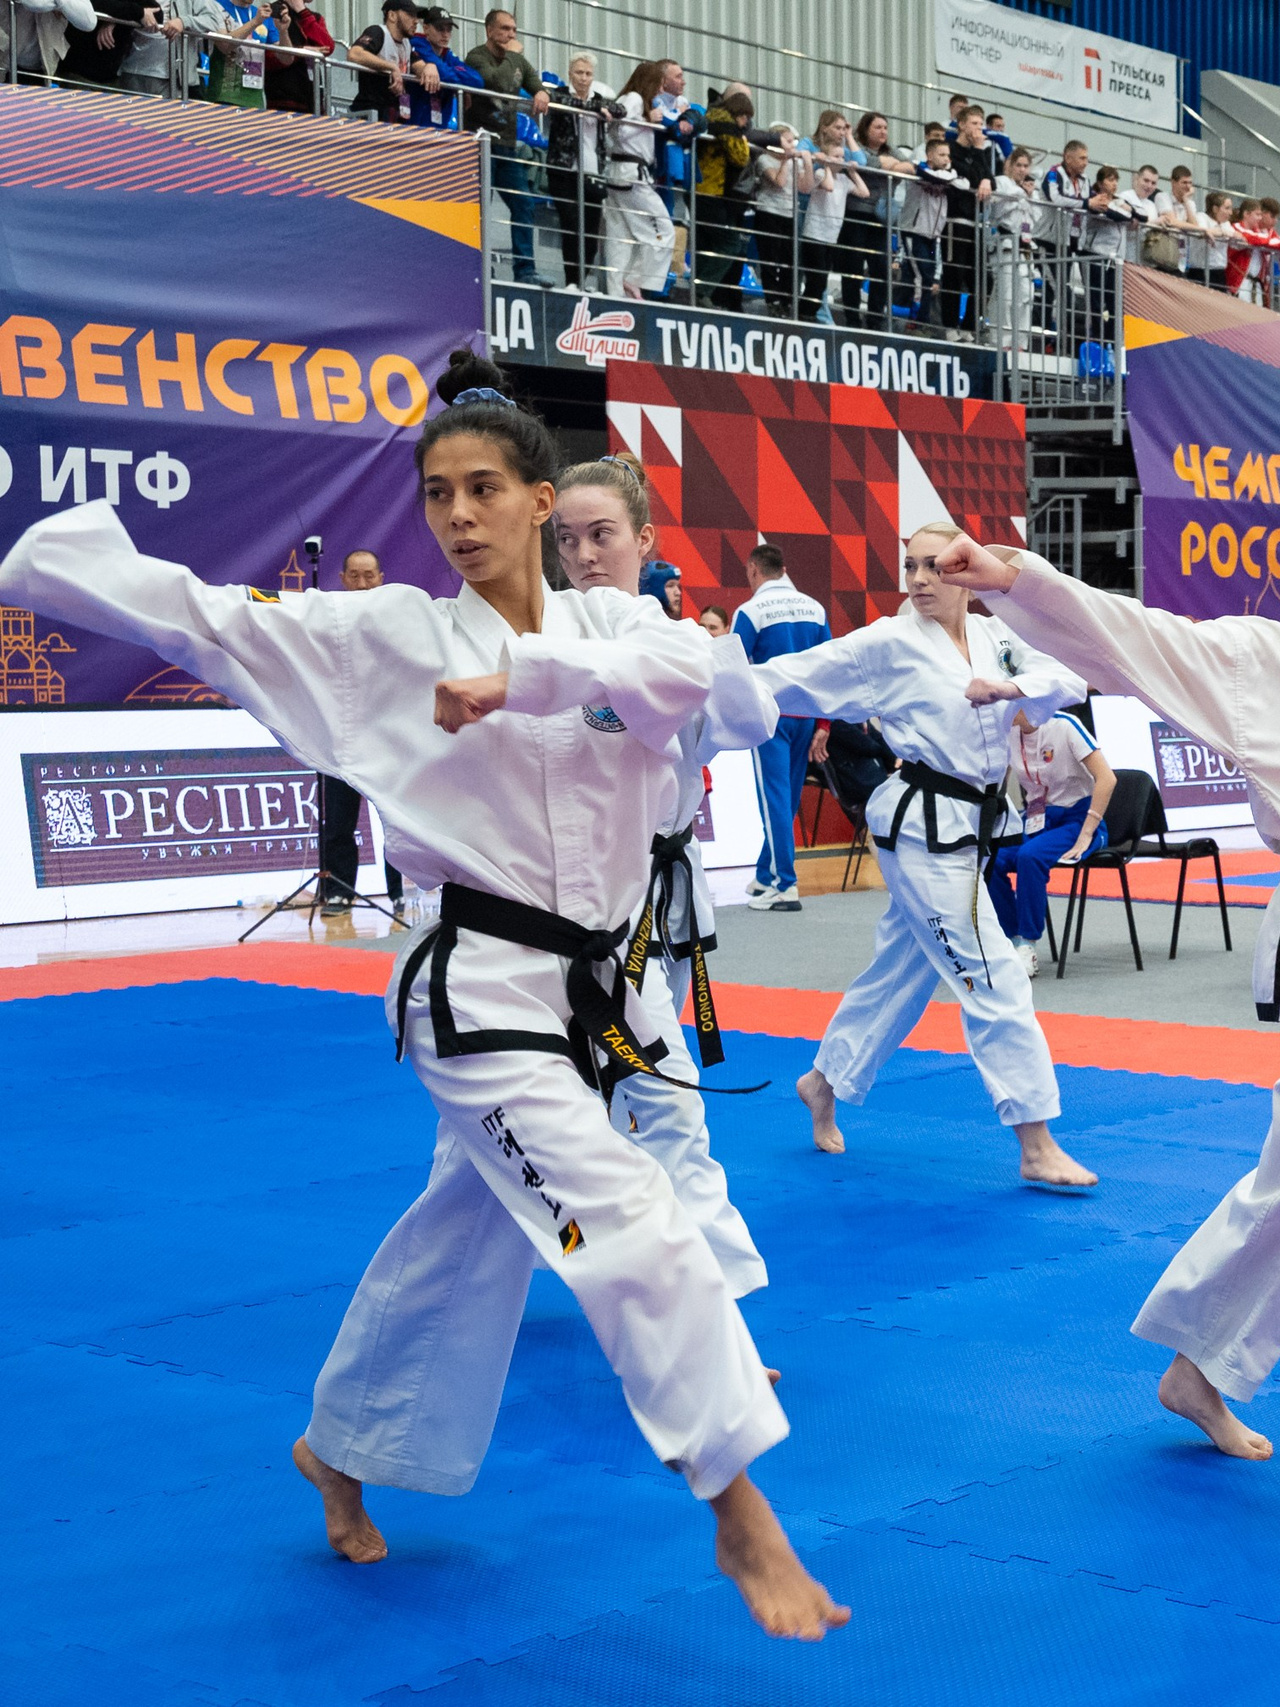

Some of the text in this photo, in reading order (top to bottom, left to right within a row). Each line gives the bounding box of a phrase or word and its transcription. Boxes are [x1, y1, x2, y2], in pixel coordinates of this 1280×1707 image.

[951, 16, 1065, 58] ИНФОРМАЦИОННЫЙ
[1109, 78, 1152, 101] ПРЕССА
[1110, 60, 1165, 87] ТУЛЬСКАЯ
[656, 318, 970, 398] ТУЛЬСКАЯ ОБЛАСТЬ
[39, 445, 191, 509] ИТФ
[797, 608, 816, 617] TEAM
[100, 781, 319, 839] РЕСПЕК
[927, 916, 942, 928] ITF
[694, 942, 714, 1032] TAEKWONDO
[481, 1106, 505, 1136] ITF
